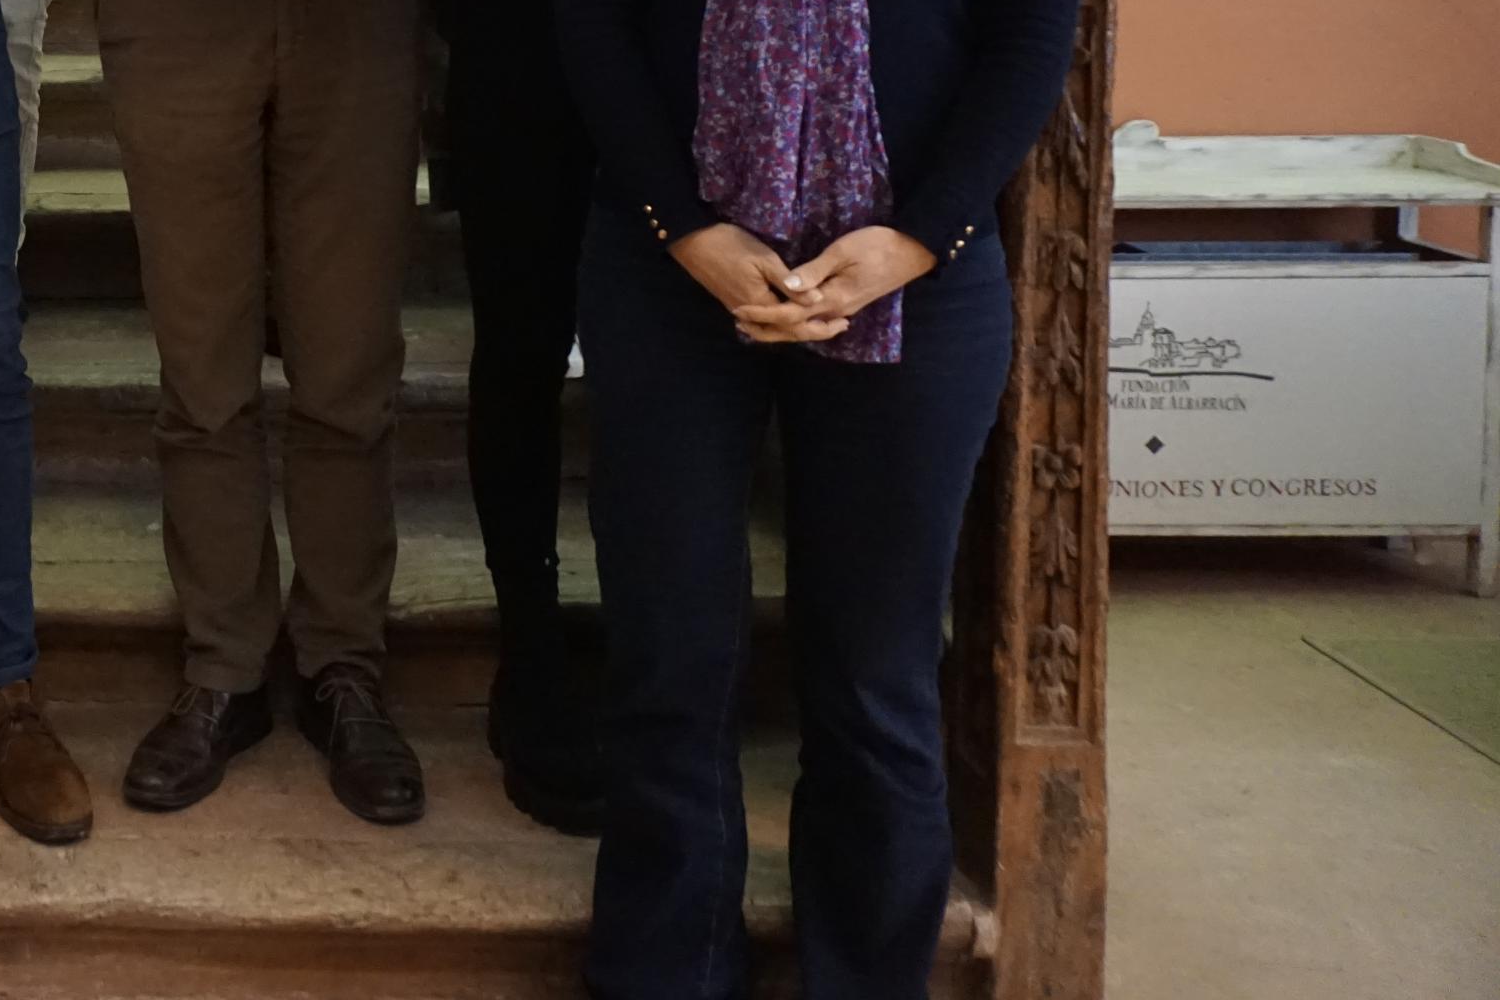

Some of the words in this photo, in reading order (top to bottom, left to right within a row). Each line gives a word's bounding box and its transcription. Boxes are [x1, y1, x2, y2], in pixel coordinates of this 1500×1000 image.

[1121, 376, 1190, 393] FUNDACIÓN
[1150, 397, 1165, 410] DE
[1211, 479, 1224, 496] Y
[1231, 478, 1377, 496] CONGRESOS
